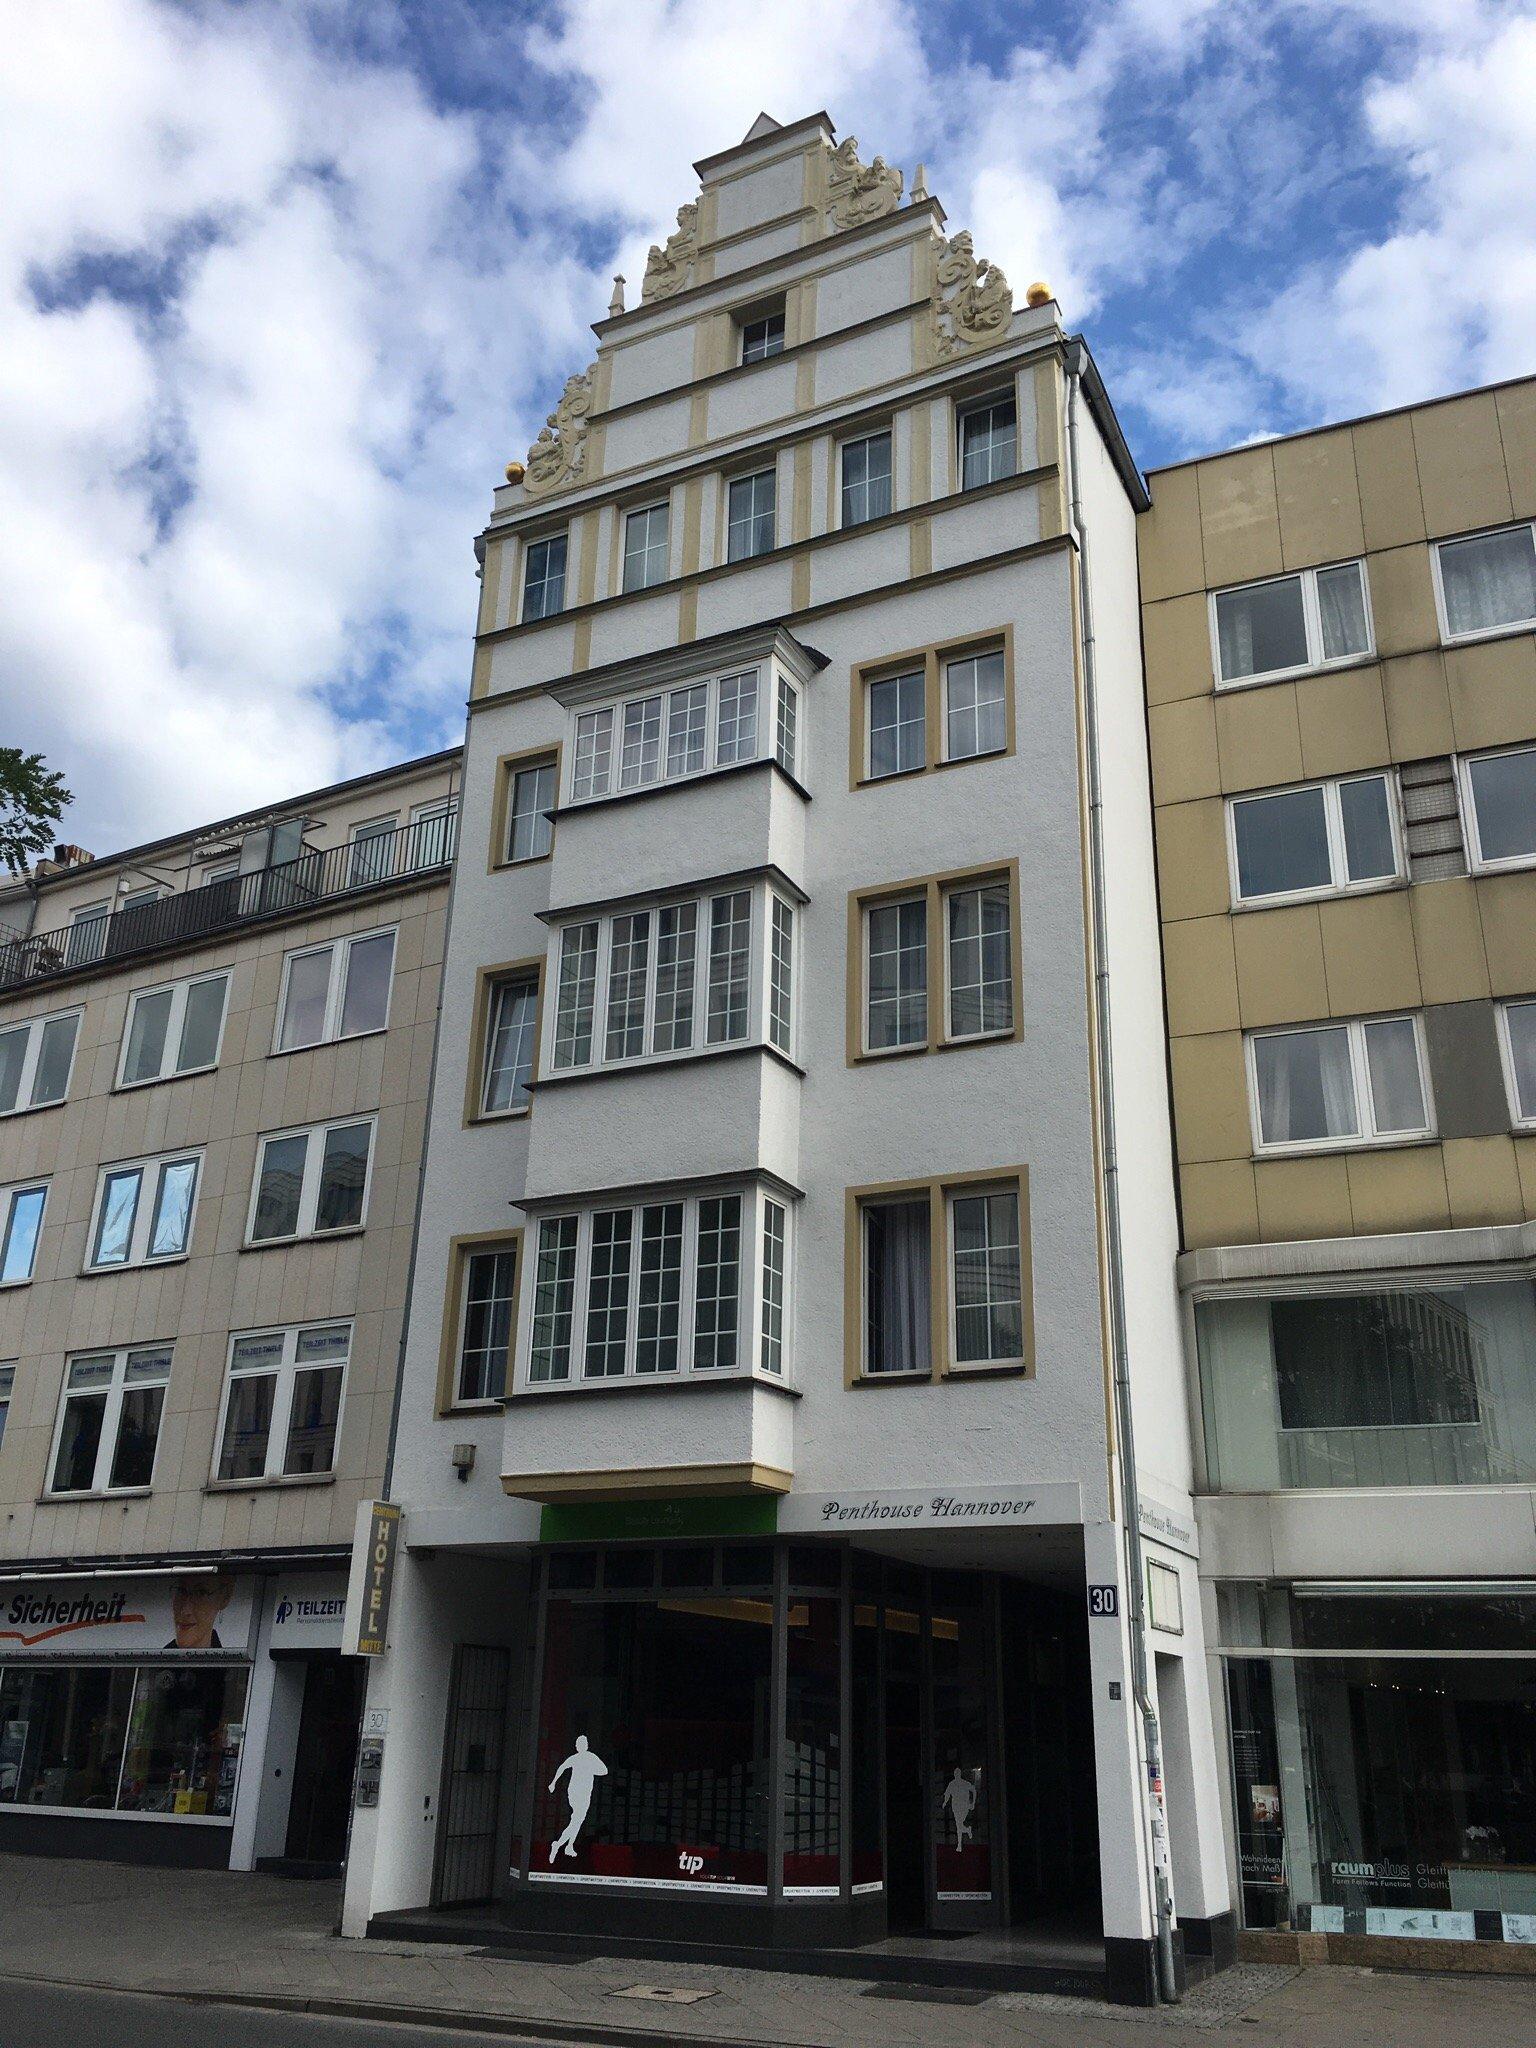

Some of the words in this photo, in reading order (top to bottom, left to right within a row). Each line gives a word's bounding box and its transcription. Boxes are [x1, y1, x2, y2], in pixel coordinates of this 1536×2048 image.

[820, 1500, 923, 1521] Penthouse
[929, 1496, 1037, 1517] Hannover
[367, 1519, 391, 1634] HOTEL
[8, 1593, 126, 1624] Sicherheit
[297, 1600, 346, 1616] TEILZEIT
[1092, 1588, 1114, 1613] 30
[370, 1713, 384, 1728] 30
[678, 1851, 704, 1875] tip
[1331, 1857, 1410, 1879] raumplus
[1380, 1880, 1412, 1889] Function
